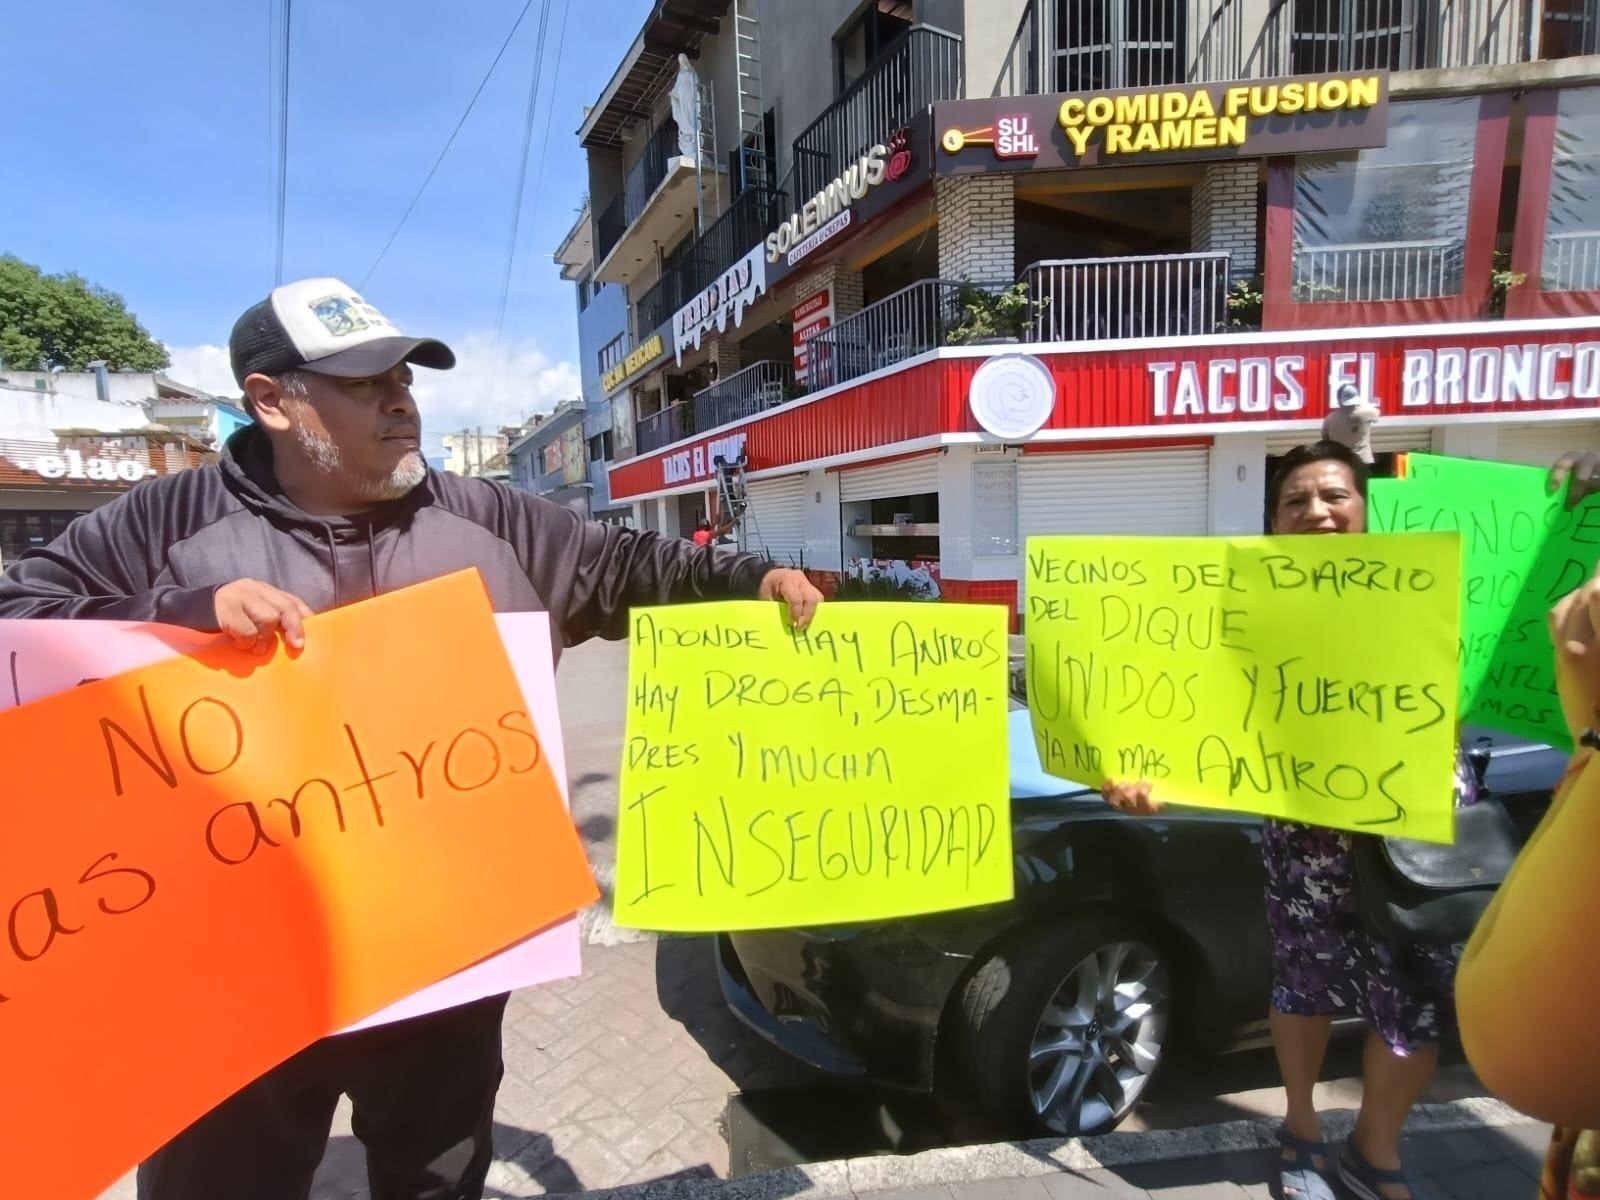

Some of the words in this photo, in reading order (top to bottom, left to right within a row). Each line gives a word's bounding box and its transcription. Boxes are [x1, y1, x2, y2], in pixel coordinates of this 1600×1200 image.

[998, 117, 1028, 136] SU
[1058, 90, 1217, 127] COMIDA
[1225, 76, 1380, 117] FUSION
[1065, 125, 1094, 156] Y
[1106, 117, 1247, 155] RAMEN
[766, 144, 887, 263] SOLEMNUS
[1148, 356, 1305, 417] TACOS
[1328, 352, 1381, 409] EL
[1029, 549, 1147, 587] VECINOS
[1172, 563, 1247, 593] DEL
[1260, 555, 1435, 598] BARRIO
[636, 613, 769, 669] ADONDE
[790, 626, 864, 674] HAY
[890, 620, 1002, 676] ANTROS
[1031, 595, 1079, 622] DEL
[1100, 594, 1254, 653] DIQUE
[635, 672, 679, 732] HAY
[1031, 640, 1199, 722] UNIDOS
[1242, 664, 1259, 732] Y
[1272, 656, 1446, 735] FUERTES
[99, 684, 244, 797] NO
[628, 735, 701, 771] DRES
[728, 731, 743, 779] Y
[761, 744, 894, 788] MUCHA
[205, 710, 541, 866] antros
[1039, 728, 1067, 771] YA
[1074, 740, 1102, 769] NO
[1198, 731, 1407, 827] ANTROS
